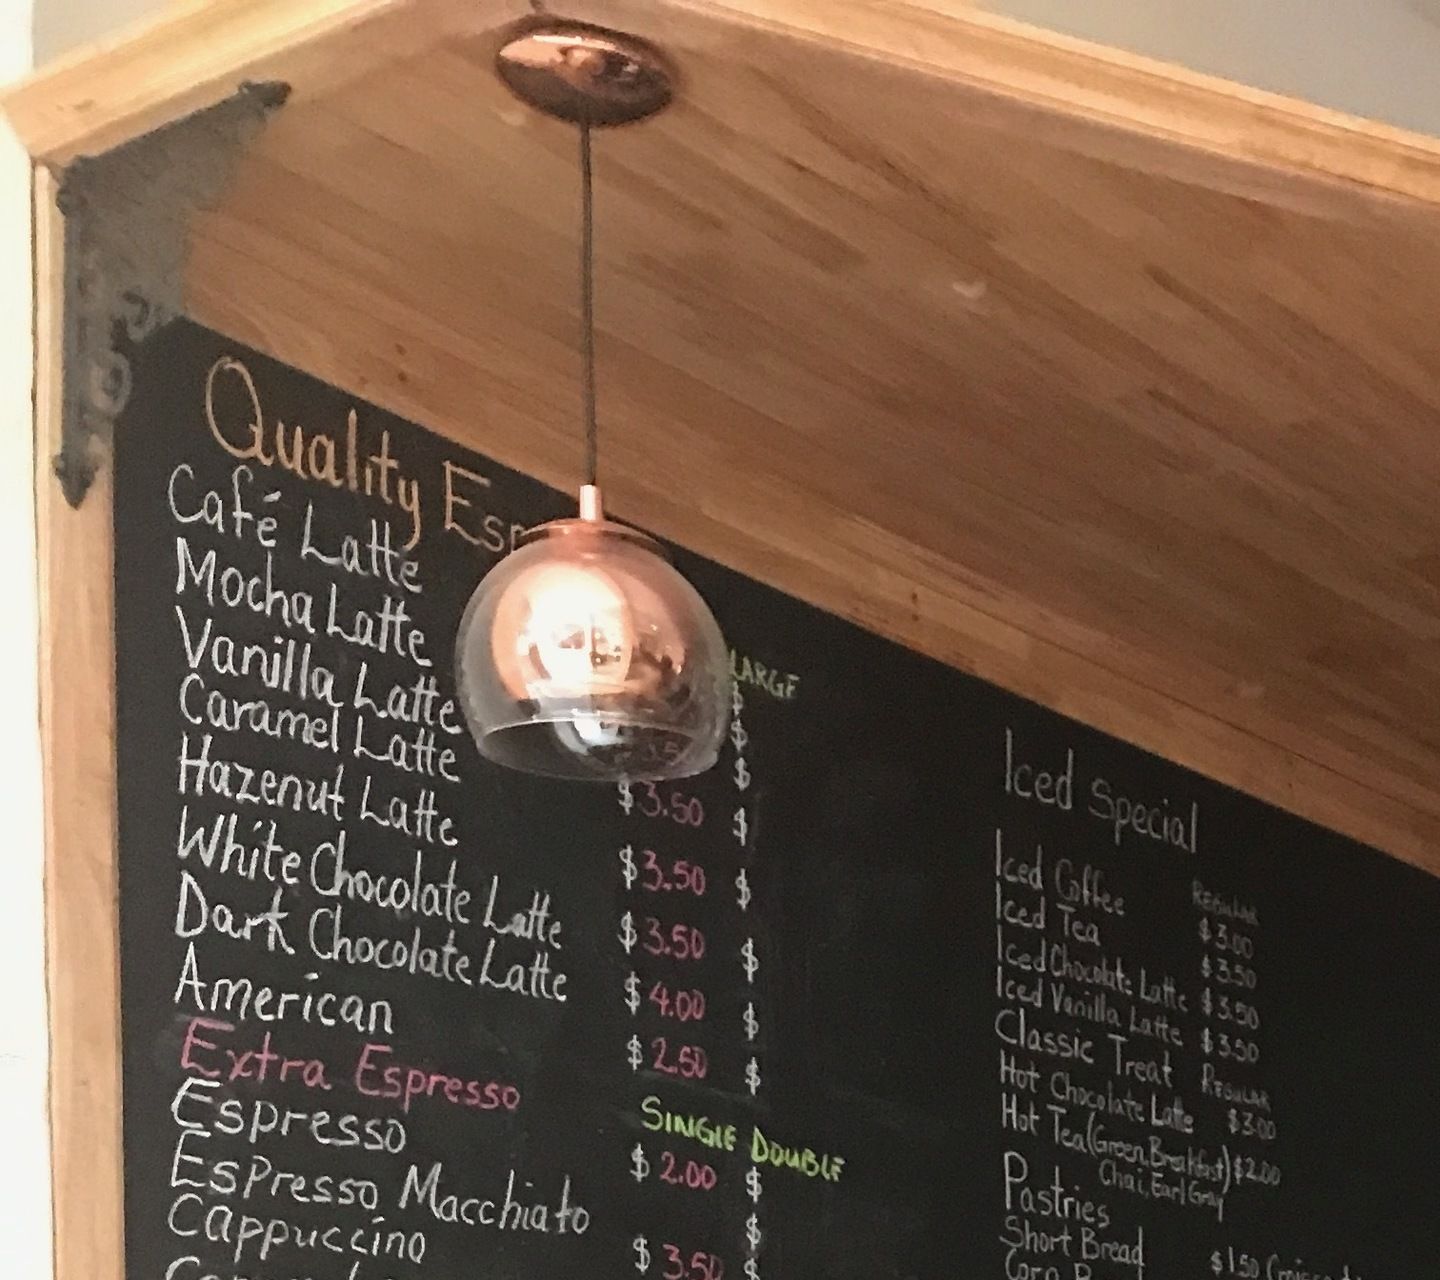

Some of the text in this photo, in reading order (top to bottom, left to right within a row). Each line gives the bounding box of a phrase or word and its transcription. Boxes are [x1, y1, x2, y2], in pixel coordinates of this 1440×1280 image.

[206, 356, 421, 551] Quality
[168, 464, 423, 594] Café Latte
[176, 537, 431, 667] Mocha Latte
[176, 605, 463, 734] Vanilla Latte
[180, 673, 461, 783] Caramel Latte
[178, 732, 459, 847] Hazenut Latte
[1005, 726, 1198, 853] Iced Special
[177, 806, 562, 950] White Chocolate Latte
[996, 828, 1125, 917] Iced Coffee
[996, 881, 1046, 930] Iced
[1055, 902, 1101, 946] Tea
[175, 870, 567, 1002] Dark Chocolate Latte
[997, 925, 1047, 974] Iced
[174, 941, 395, 1035] American
[997, 966, 1044, 1009] Iced
[1051, 983, 1122, 1028] Vanilla
[1130, 1004, 1184, 1048] Latte
[180, 1016, 521, 1112] Extra Espresso
[994, 1007, 1095, 1065] Classic
[1107, 1033, 1174, 1088] Treat
[1000, 1049, 1041, 1094] Hot
[1050, 1072, 1146, 1124] Chocolate
[171, 1077, 407, 1155] Espresso
[640, 1095, 846, 1182] SINGLE DOUBLE
[1001, 1091, 1041, 1137] Hot
[167, 1192, 426, 1264] Cappuccino
[398, 1162, 590, 1235] Macchiato
[1004, 1149, 1110, 1229] Pastries
[999, 1214, 1146, 1268] Short Bread
